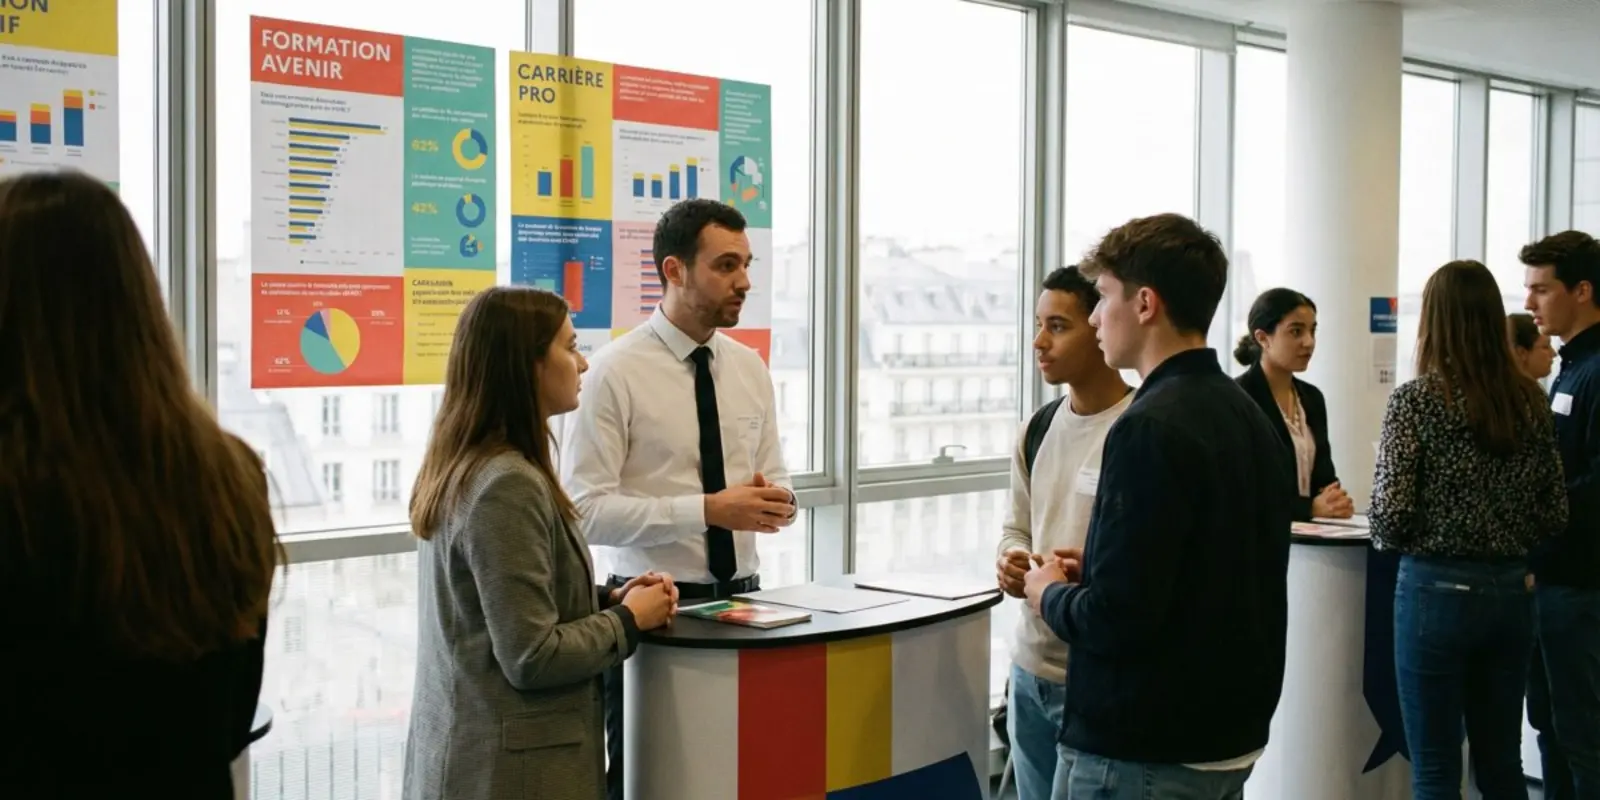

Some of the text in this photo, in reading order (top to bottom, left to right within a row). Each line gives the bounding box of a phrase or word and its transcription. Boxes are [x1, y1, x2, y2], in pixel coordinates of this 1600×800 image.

[261, 28, 391, 62] FORMATION
[261, 53, 343, 80] AVENIR
[517, 63, 604, 88] CARRIÈRE
[518, 84, 556, 104] PRO
